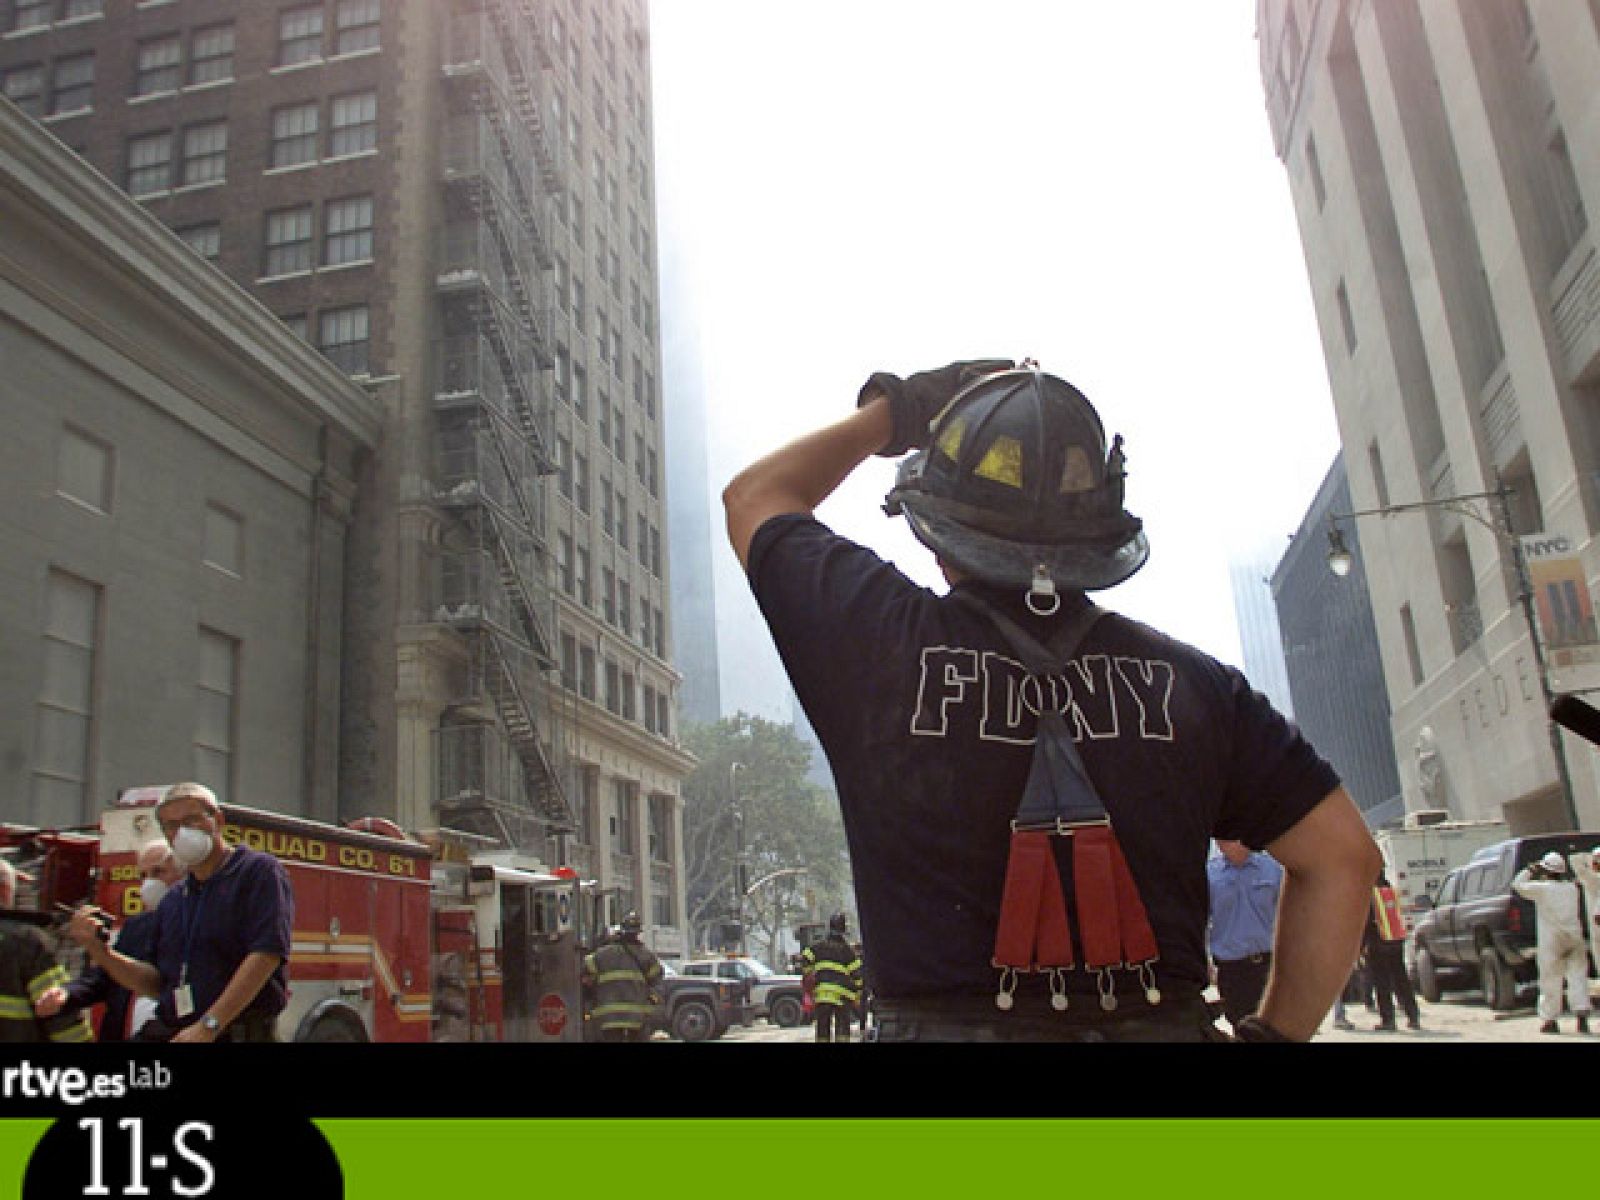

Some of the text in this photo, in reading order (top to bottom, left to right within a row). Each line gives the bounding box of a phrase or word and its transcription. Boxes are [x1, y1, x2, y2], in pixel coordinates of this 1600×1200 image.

[1523, 538, 1569, 556] NYC
[910, 645, 1174, 745] FDNY
[221, 824, 416, 877] SQUAD CO. 61
